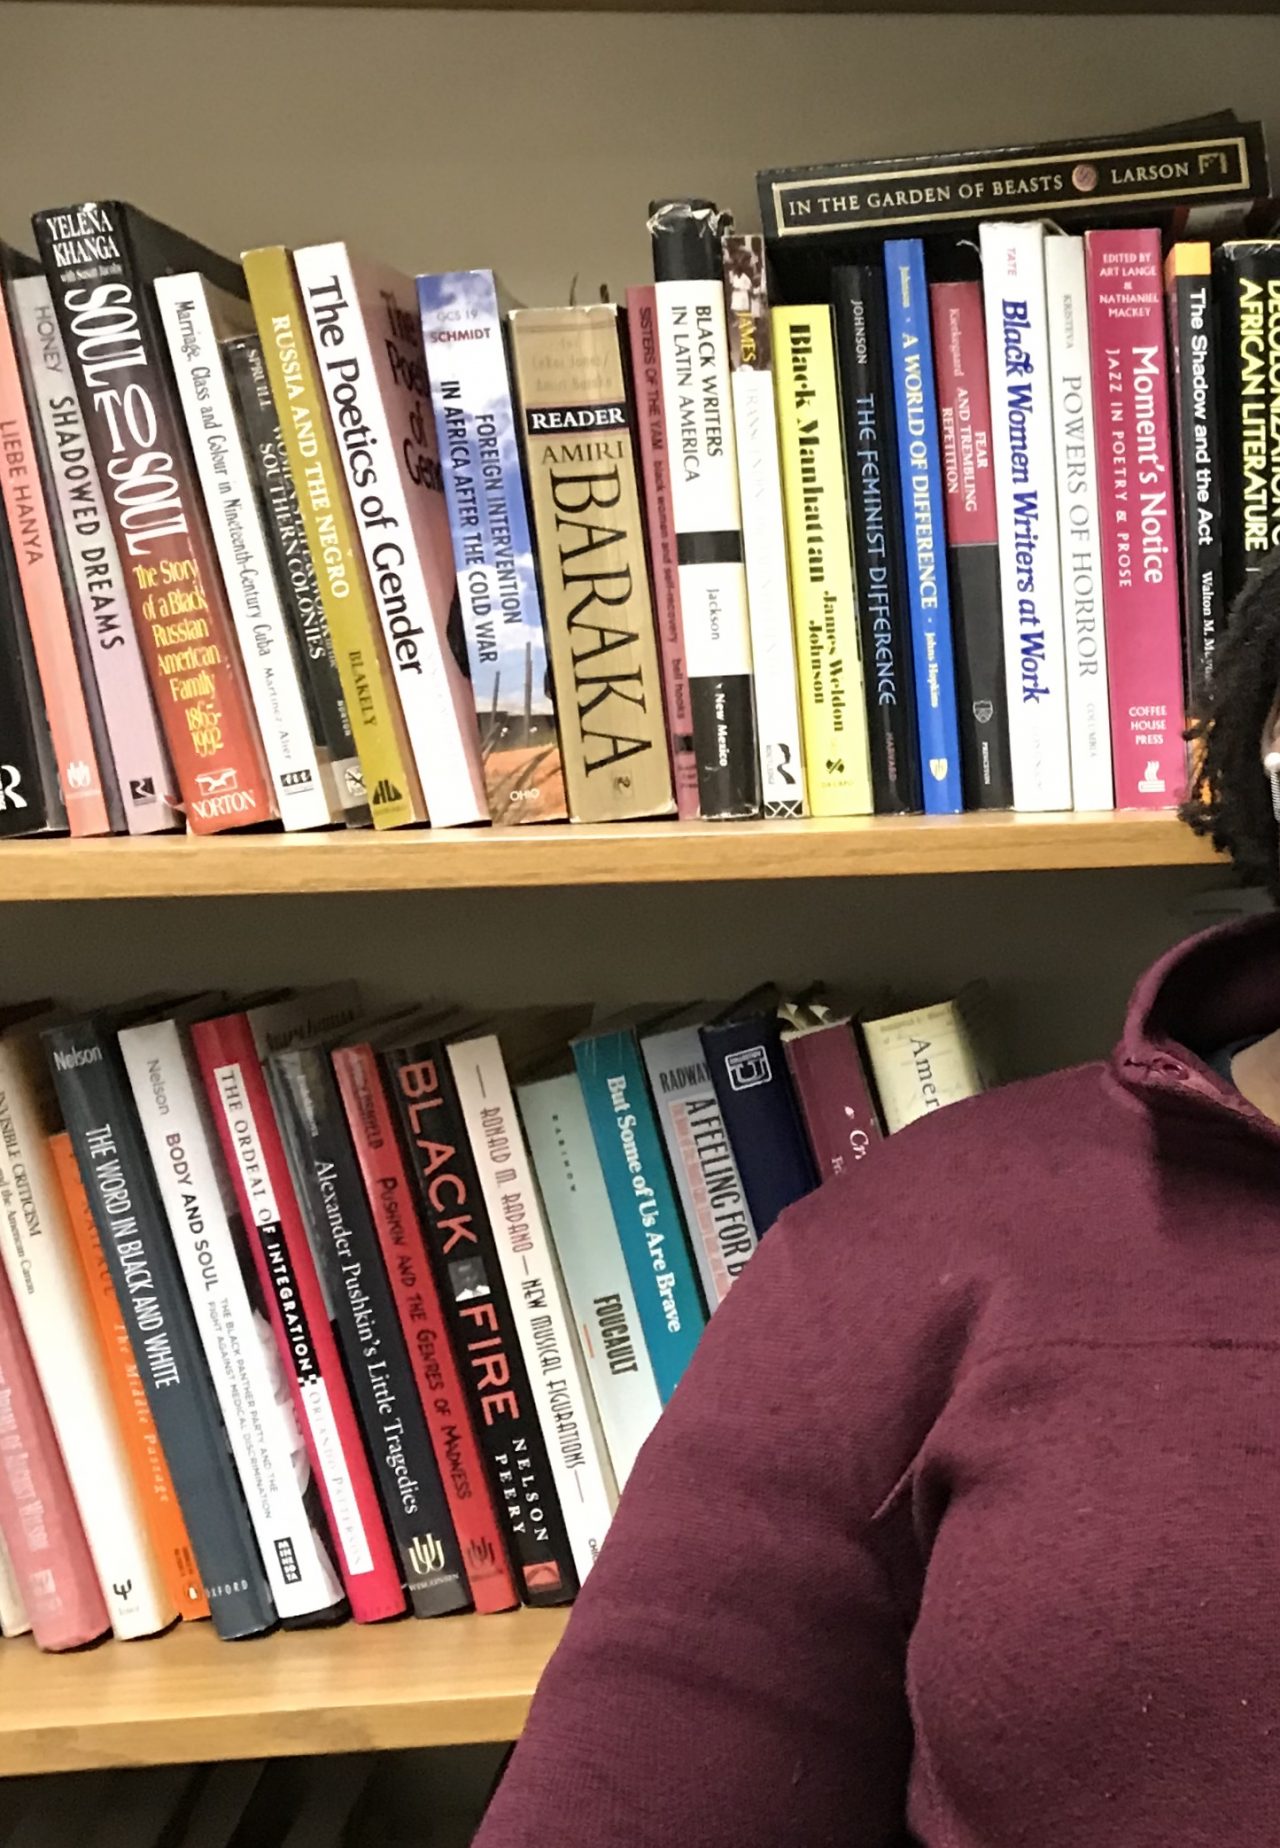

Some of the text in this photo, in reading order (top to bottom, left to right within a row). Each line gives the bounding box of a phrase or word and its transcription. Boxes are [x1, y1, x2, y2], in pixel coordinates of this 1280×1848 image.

[788, 162, 1189, 216] IN THE GARDEN OF BEASTS LARSON
[52, 236, 121, 267] KHANGA
[1100, 265, 1119, 277] ART
[1103, 252, 1151, 264] EDITED BY
[64, 283, 147, 388] SOUL
[308, 275, 348, 347] The
[430, 328, 491, 343] SCHMIDT
[851, 300, 868, 365] JOHNSON
[1002, 298, 1034, 377] Black
[1099, 293, 1159, 304] NATHANIEL
[1108, 306, 1151, 318] MACKEY
[94, 383, 156, 453] TO
[531, 407, 625, 429] READER
[671, 306, 700, 483] IN LATIN AMERICA
[695, 305, 723, 457] BLACK WRITERS
[856, 393, 877, 441] THE
[1240, 278, 1268, 551] AFRICAN LITERATURE
[328, 357, 377, 487] Poetics
[542, 440, 624, 465] AMIRI
[788, 323, 825, 583] Black Manhattan
[957, 387, 977, 512] AND TREMBLING
[975, 431, 989, 468] FEAR
[1007, 382, 1033, 485] Women
[1190, 287, 1214, 616] The Shadow and the Act Walton
[33, 305, 125, 650] HONEY SHADOWED DREAMS
[107, 451, 189, 557] SOUL
[857, 449, 886, 557] FEMINIST
[902, 333, 938, 609] A WORLD OF DIFFERENCE
[1105, 348, 1132, 588] JAZZ IN POETRY PROSE
[1132, 346, 1169, 584] Moment's Notice
[190, 366, 272, 658] Class and in Cuba
[272, 314, 378, 727] RUSSIA AND THE NEGRO BLAKELY
[360, 496, 398, 529] of
[441, 380, 497, 664] IN AFRICA AFTER THE COLD WAR
[475, 413, 522, 624] FOREIGN INTERVENTION
[1013, 490, 1039, 594] Writers
[1062, 376, 1099, 678] POWERS OF HORROR
[152, 618, 208, 648] Russian
[169, 586, 208, 613] Black
[372, 542, 424, 674] Gender
[550, 463, 652, 777] BARAKA
[868, 566, 896, 706] DIFFERENCE
[1019, 598, 1041, 626] at
[158, 645, 221, 676] American
[170, 671, 216, 701] Family
[1020, 630, 1050, 704] Work
[1128, 705, 1167, 717] COFFEE
[1131, 719, 1166, 731] HOUSE
[1135, 734, 1163, 745] PRESS
[191, 789, 256, 821] NORTON
[53, 1045, 102, 1071] Nelson
[86, 1123, 116, 1159] THE
[147, 1058, 219, 1292] Nelson BODY AND SOUL
[686, 1098, 753, 1261] A FOR
[13, 1163, 42, 1238] CRITICISM
[95, 1157, 132, 1222] WORD
[111, 1217, 139, 1239] IN
[221, 1070, 312, 1372] THE OF INTEGRATION
[607, 1075, 681, 1333] But Some of Us Are Brave
[117, 1239, 154, 1296] BLACK
[399, 1058, 520, 1426] BLACK FIRE
[133, 1298, 164, 1333] AND
[314, 1160, 396, 1414] Alexander Pushkin's Little
[143, 1333, 181, 1390] WHITE
[594, 1293, 639, 1376] FOUCAULT
[208, 1301, 272, 1519] FIGHT AGAINST MEDICAL DISCRIMINATION
[221, 1297, 279, 1494] THE BLACK PANTHER PARTY AND THE
[496, 1454, 526, 1535] PEERY
[512, 1438, 549, 1542] NELSON
